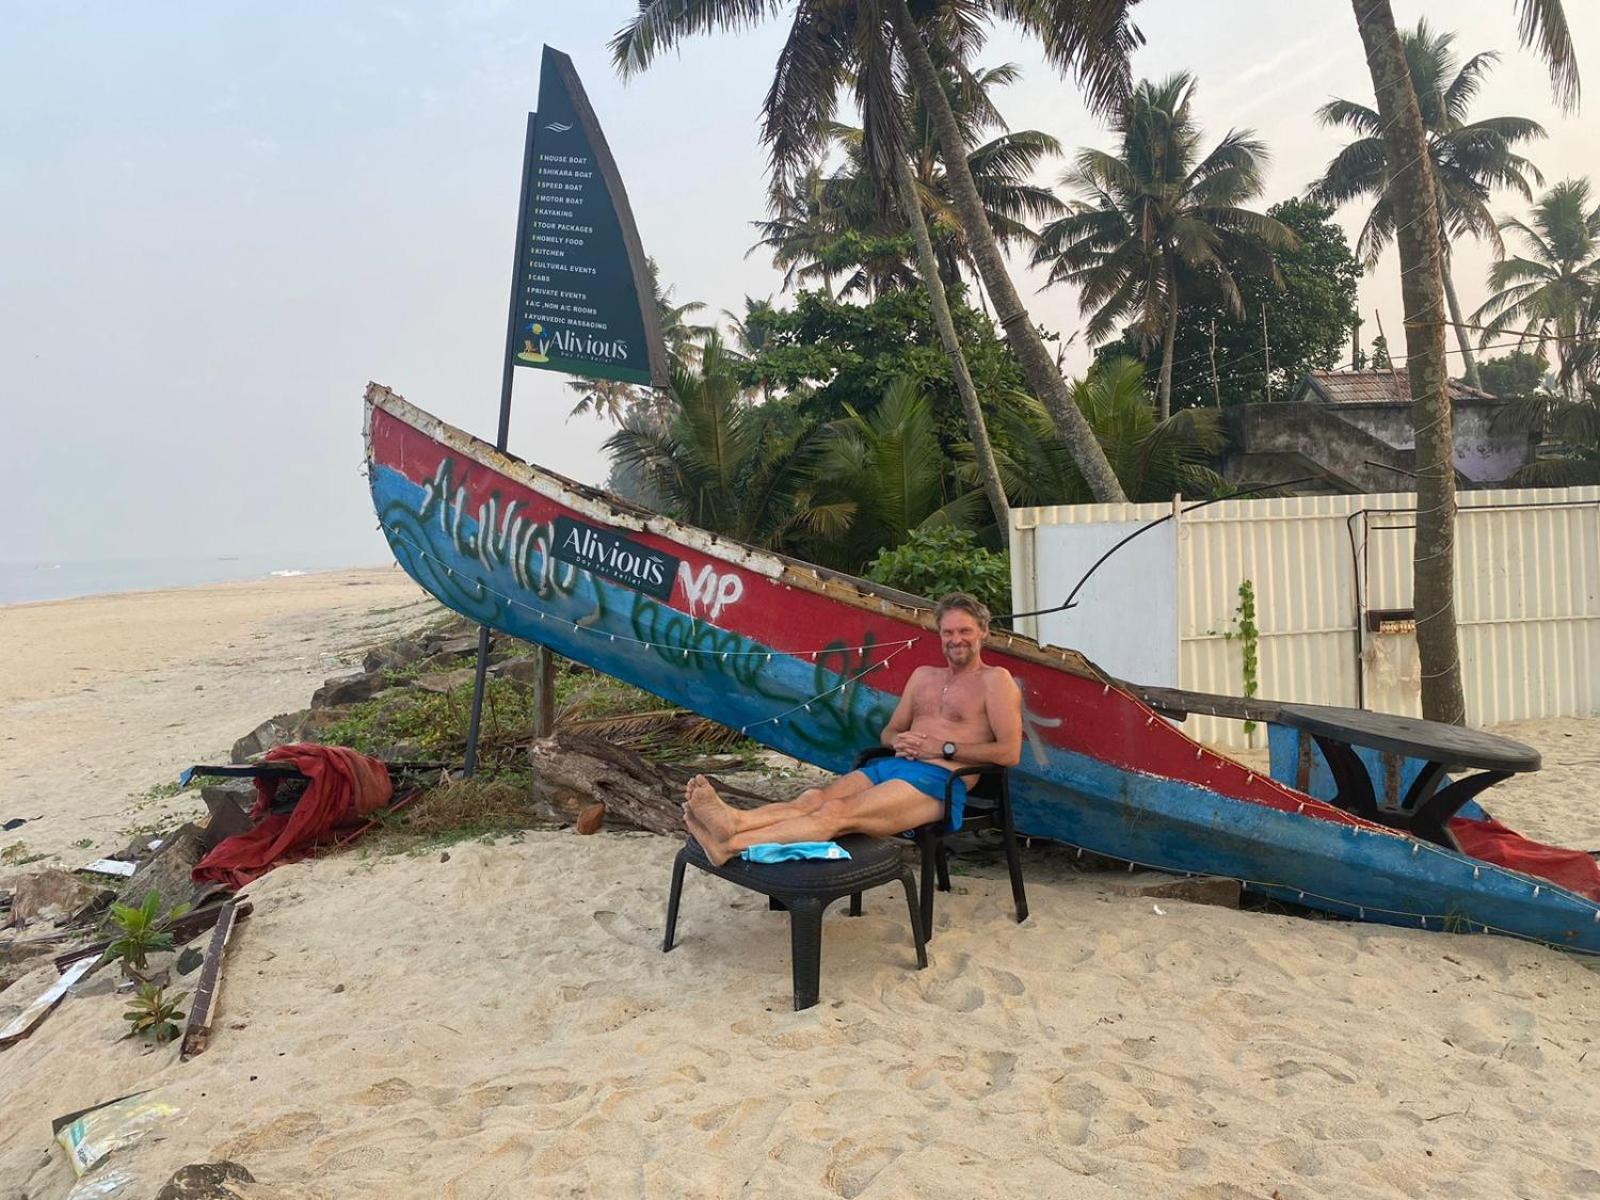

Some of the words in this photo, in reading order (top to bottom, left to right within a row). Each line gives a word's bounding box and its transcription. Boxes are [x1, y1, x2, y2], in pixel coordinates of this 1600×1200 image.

[544, 154, 567, 163] HOUSE
[569, 156, 588, 165] BOAT
[543, 168, 572, 177] SHIKARA
[574, 171, 592, 179] BOAT
[541, 181, 563, 190] SPEED
[564, 184, 583, 192] BOAT
[540, 195, 564, 204] MOTOR
[565, 197, 584, 205] BOAT
[539, 208, 574, 218] KAYAKING
[538, 221, 556, 229] TOUR
[557, 223, 593, 234] PACKAGES
[536, 235, 563, 244] HOMELY
[564, 237, 584, 246] FOOD
[535, 248, 565, 257] KITCHEN
[533, 261, 568, 271] CULTURAL
[569, 265, 597, 275] EVENTS
[532, 274, 551, 282] CABS
[530, 287, 558, 297] PRIVATE
[560, 290, 587, 300] EVENTS
[573, 306, 598, 316] ROOMS
[528, 313, 566, 324] AYURVEDIC
[549, 330, 628, 360] Alivious
[562, 527, 665, 586] Alivious
